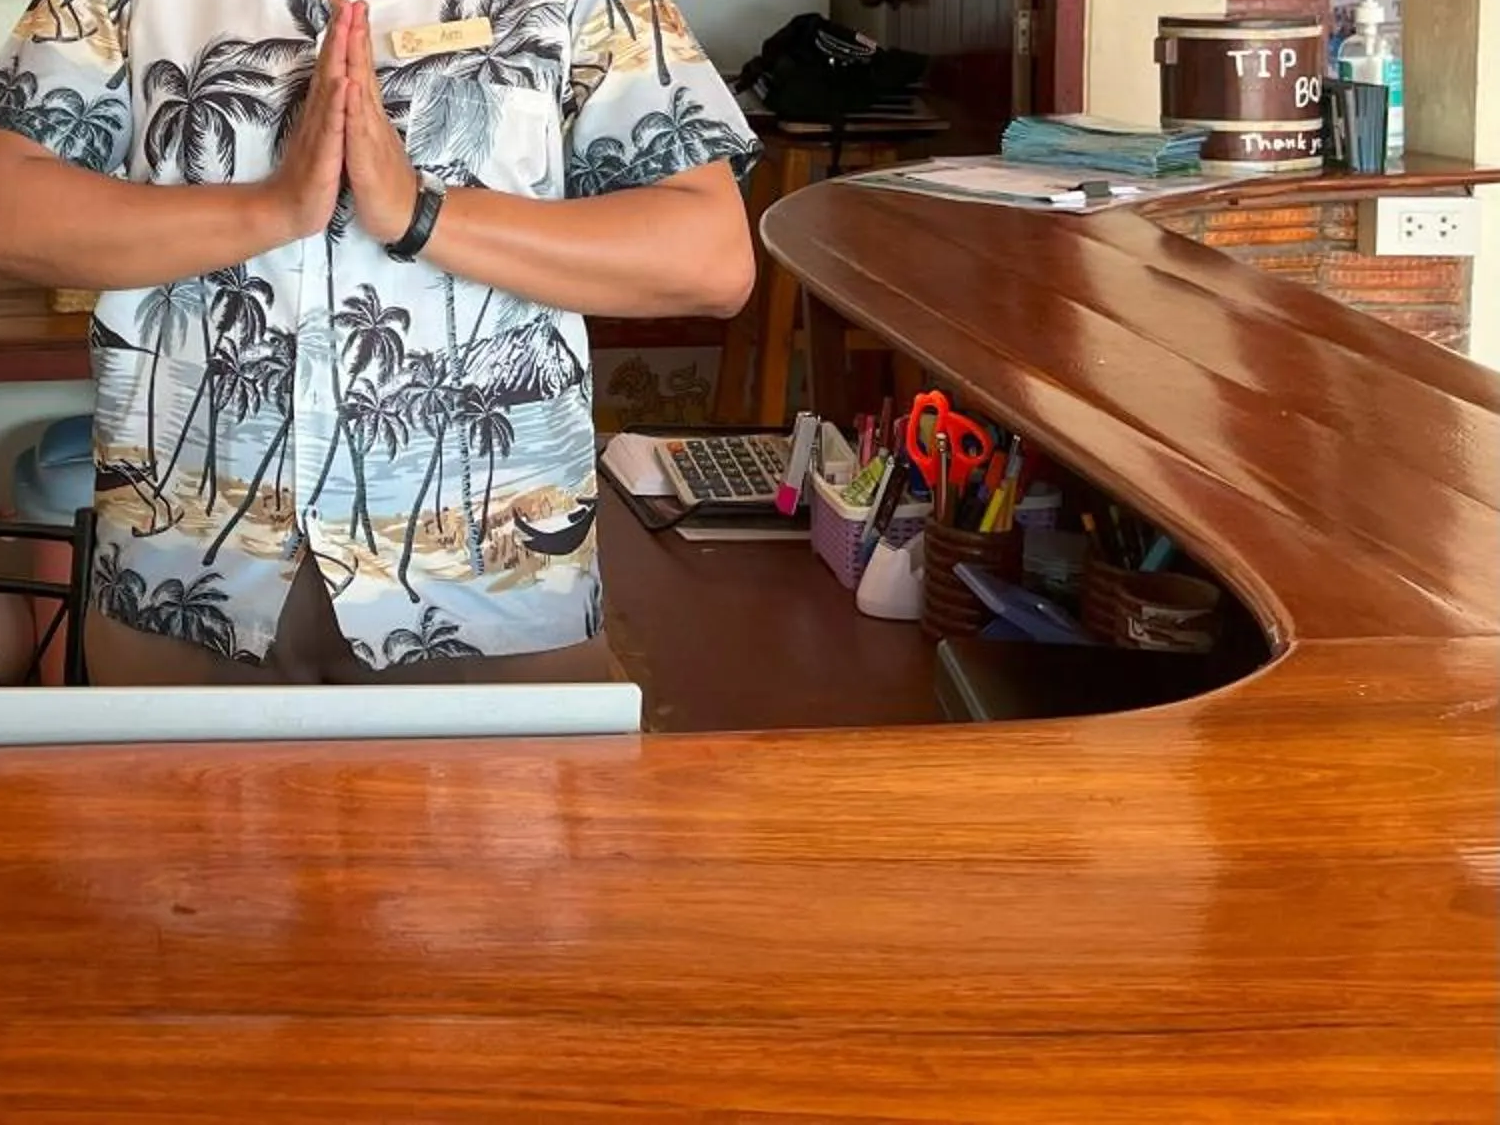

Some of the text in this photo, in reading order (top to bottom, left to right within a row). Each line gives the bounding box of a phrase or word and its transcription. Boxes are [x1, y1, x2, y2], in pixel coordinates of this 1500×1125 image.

[1226, 48, 1297, 78] TIP
[1295, 76, 1322, 108] BO
[1239, 132, 1306, 154] Thank
